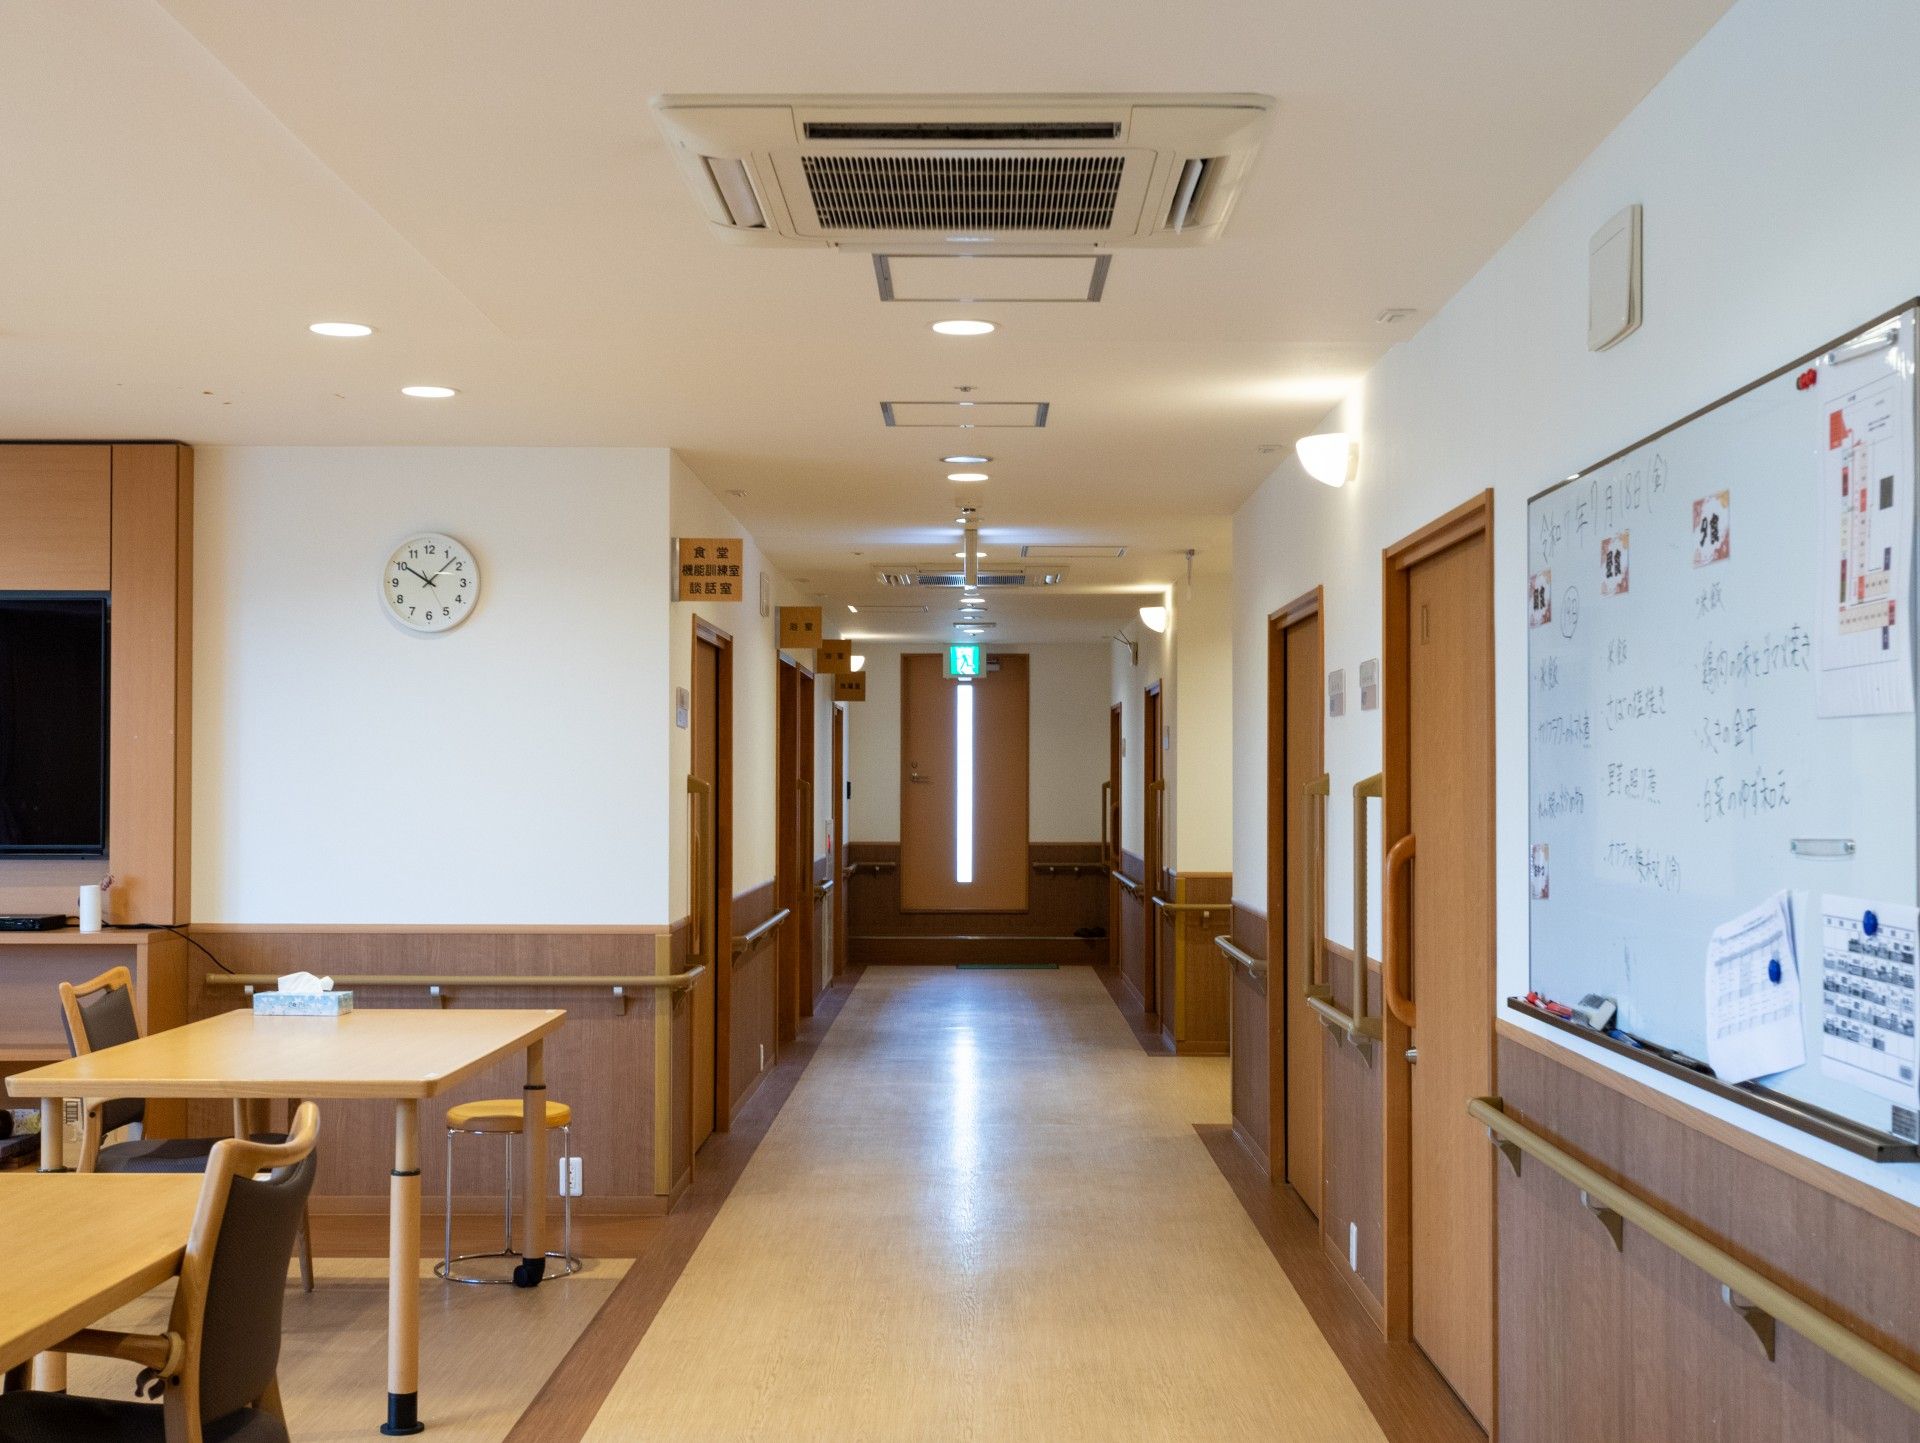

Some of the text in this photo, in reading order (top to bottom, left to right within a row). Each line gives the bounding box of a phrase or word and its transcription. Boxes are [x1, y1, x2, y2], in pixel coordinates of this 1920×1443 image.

[424, 545, 435, 554] 12
[444, 550, 449, 558] 1
[694, 546, 729, 559] 食堂
[409, 550, 418, 559] 11
[397, 562, 407, 571] 10
[456, 562, 462, 571] 2
[682, 564, 740, 577] 機能訓練室
[392, 578, 399, 587] 9
[460, 579, 467, 588] 3
[689, 582, 732, 595] 談話室
[397, 595, 404, 604] 8
[455, 595, 462, 603] 4
[409, 607, 416, 615] 7
[426, 611, 433, 620] 6
[443, 607, 450, 616] 5
